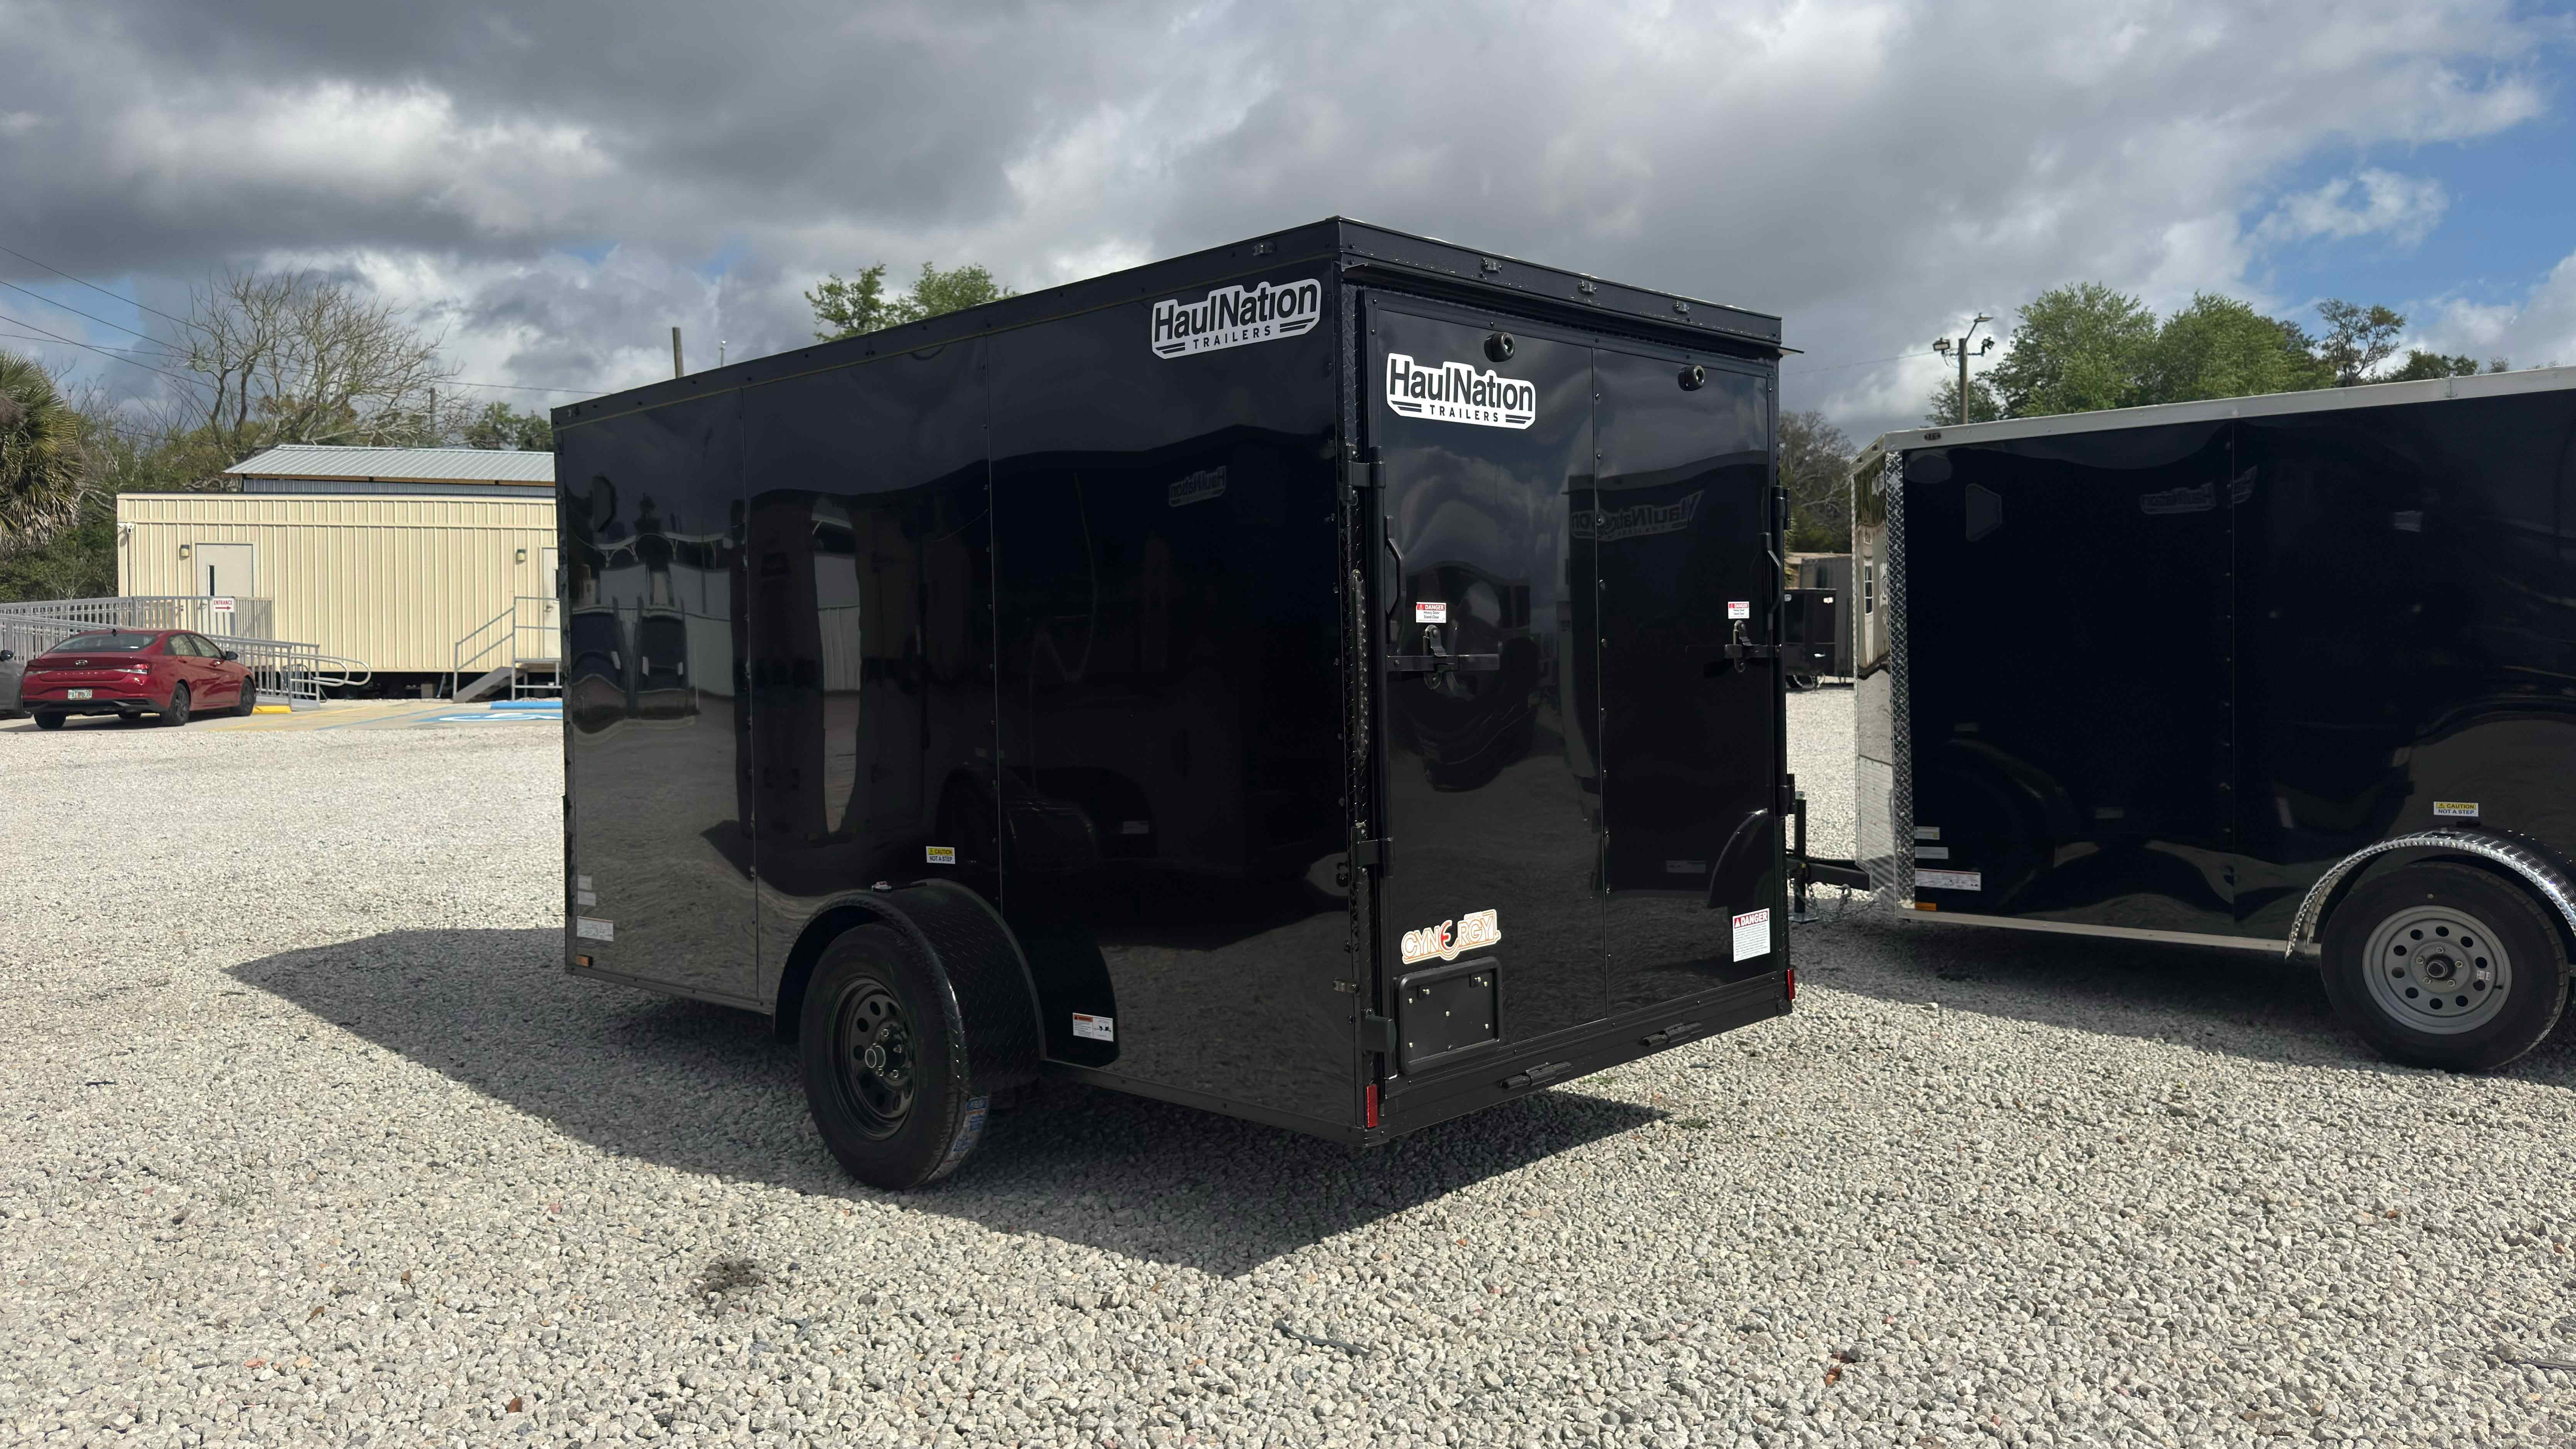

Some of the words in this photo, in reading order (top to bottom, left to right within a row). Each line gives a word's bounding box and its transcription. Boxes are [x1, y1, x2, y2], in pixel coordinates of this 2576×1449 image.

[1154, 284, 1317, 342] HaulNation
[1193, 325, 1271, 349] TRAILERS
[1390, 359, 1533, 411] HaulNation
[1430, 404, 1498, 422] TRAILERS
[1741, 911, 1767, 926] DANGER
[1404, 915, 1494, 958] CYNERGY
